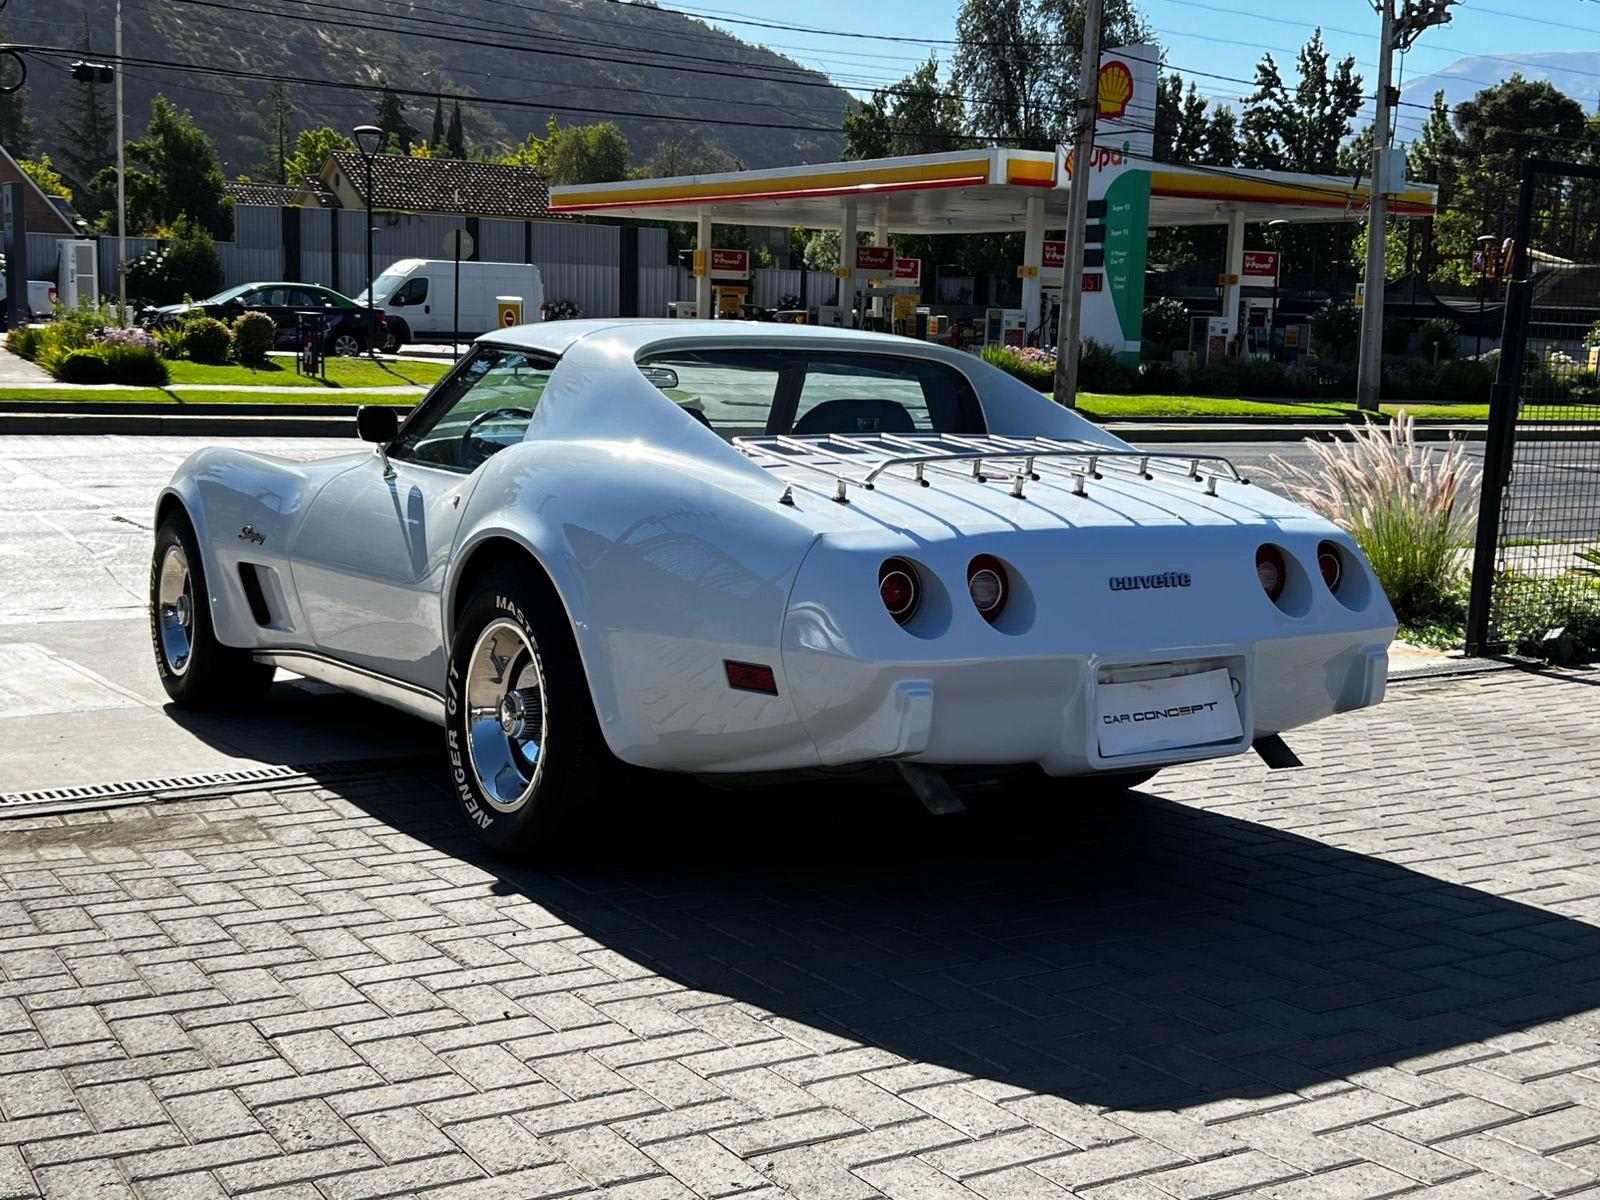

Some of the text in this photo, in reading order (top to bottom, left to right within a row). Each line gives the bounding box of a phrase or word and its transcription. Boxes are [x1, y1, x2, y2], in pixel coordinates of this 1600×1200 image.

[1103, 701, 1218, 725] CAR CONCEPT
[447, 729, 494, 829] AVENGER
